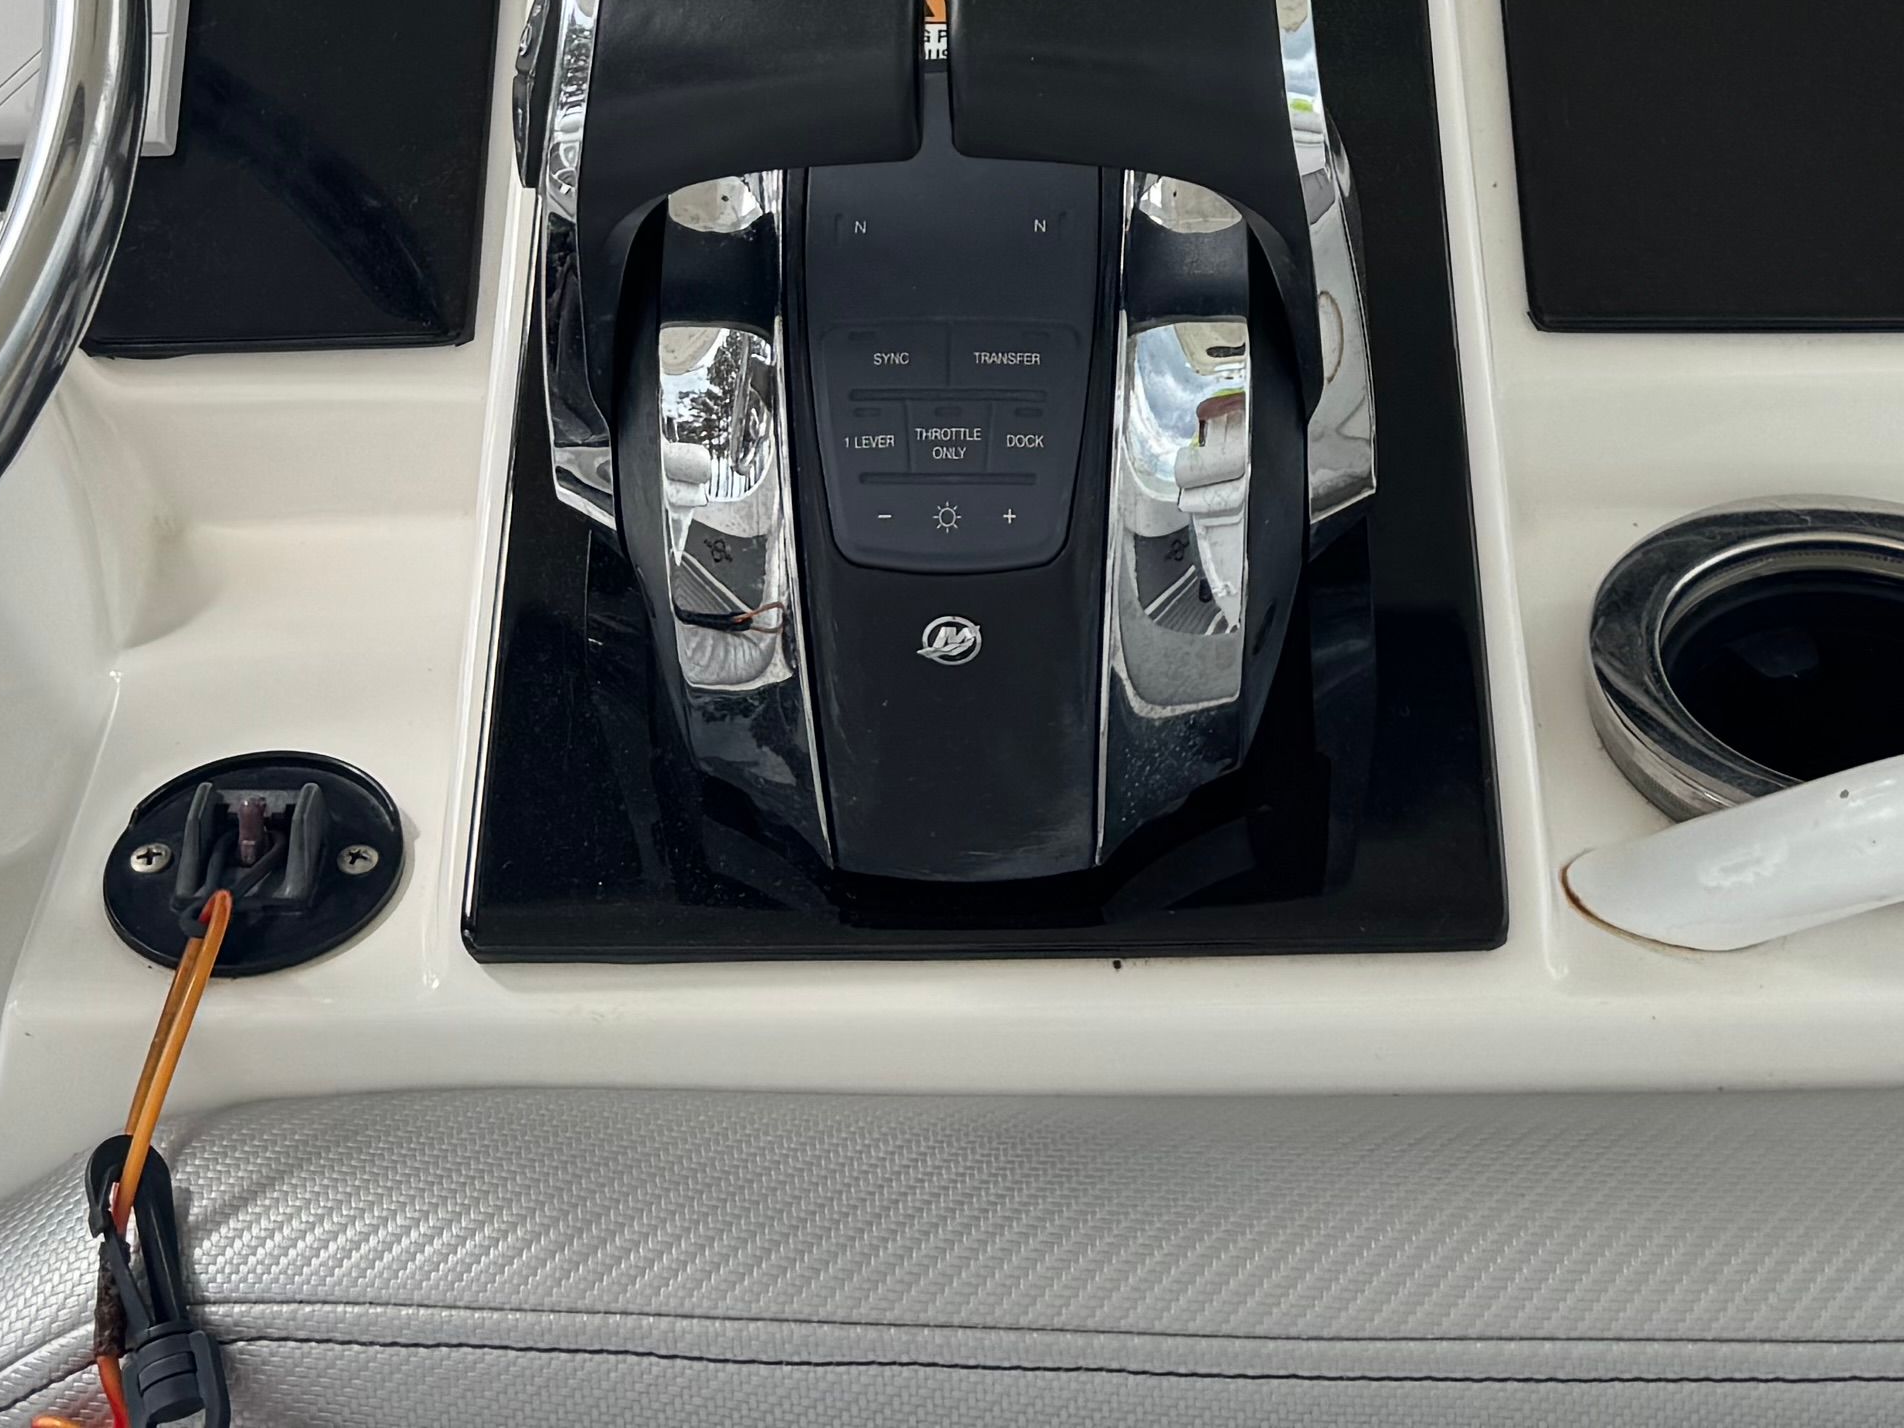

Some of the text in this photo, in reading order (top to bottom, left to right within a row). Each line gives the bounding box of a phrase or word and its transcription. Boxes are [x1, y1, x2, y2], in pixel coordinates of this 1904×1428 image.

[854, 220, 866, 234] N
[1034, 219, 1047, 233] N
[873, 352, 910, 366] SYNC
[974, 352, 1041, 366] TRANSFER
[915, 427, 982, 442] THROTTLE
[1007, 434, 1044, 449] DOCK
[855, 435, 895, 449] LEVER
[932, 446, 967, 461] ONLY
